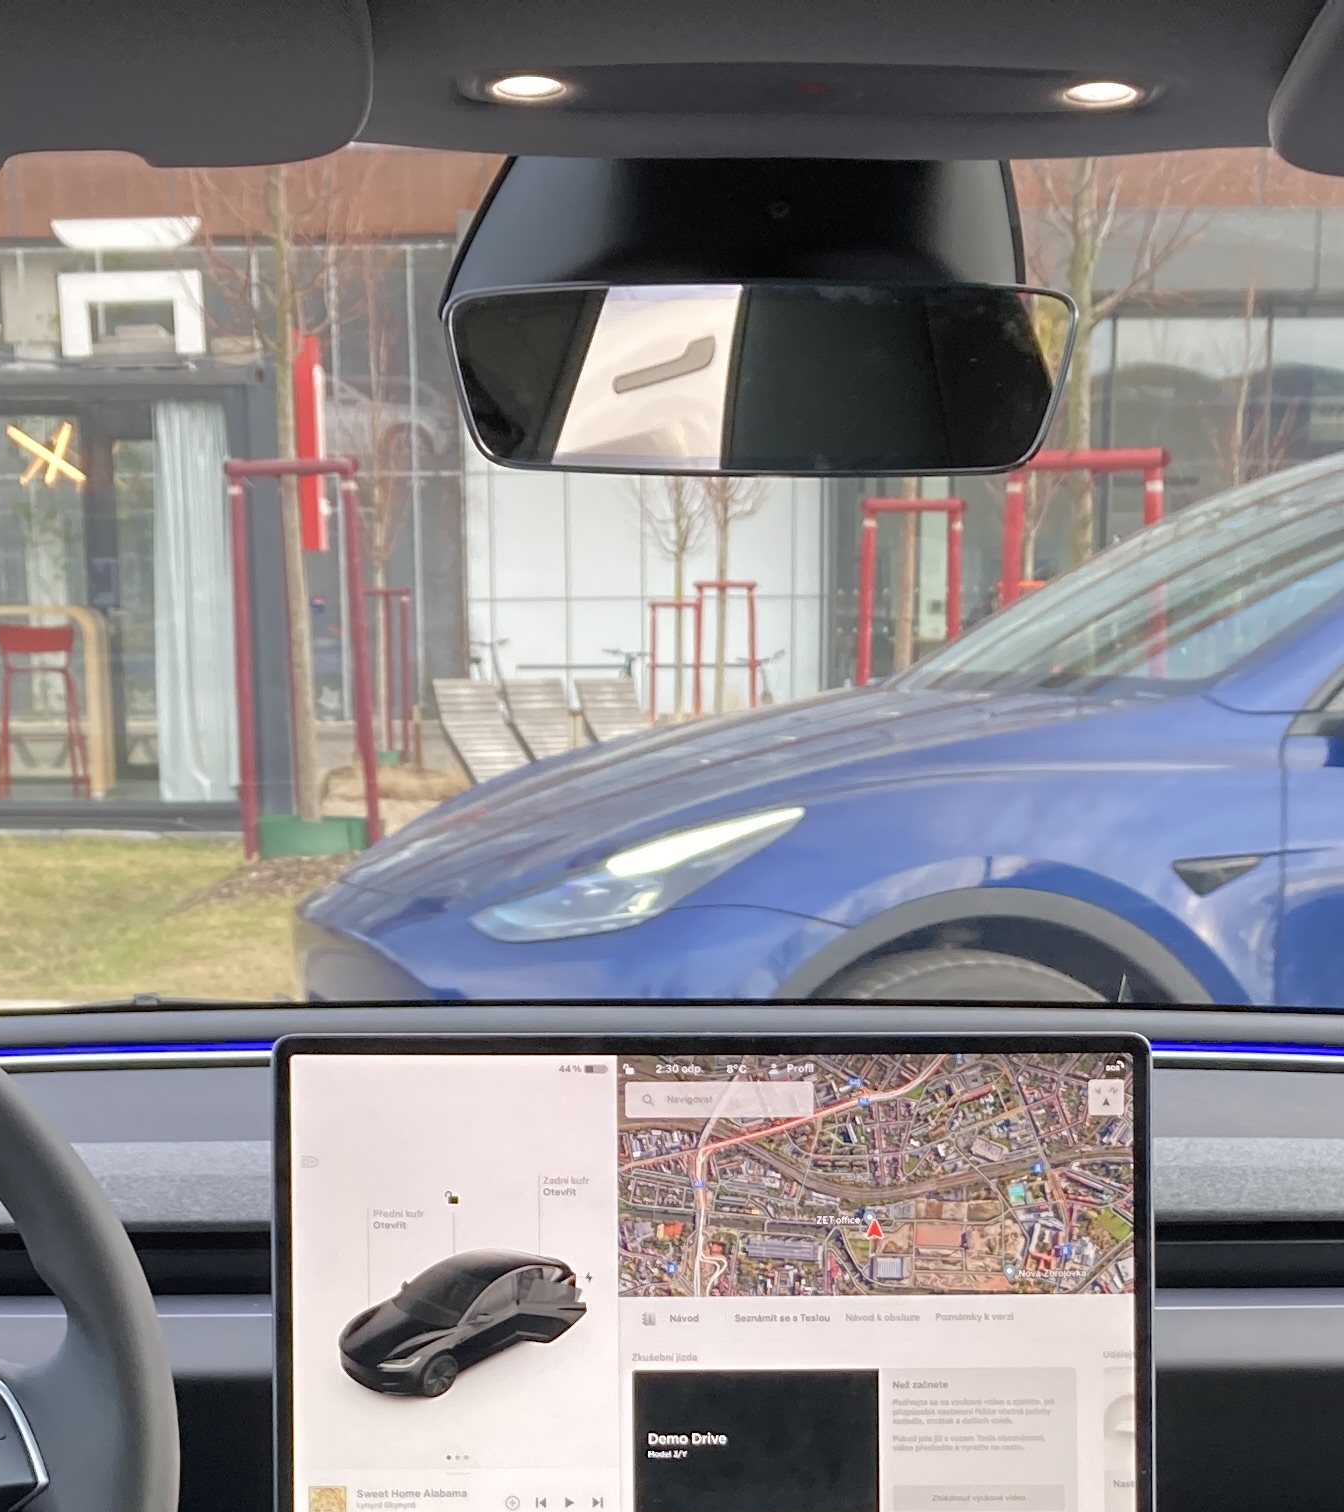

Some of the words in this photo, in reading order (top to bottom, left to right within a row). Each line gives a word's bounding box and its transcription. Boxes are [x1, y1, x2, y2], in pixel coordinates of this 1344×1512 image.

[655, 1064, 678, 1074] 2:30
[726, 1064, 747, 1074] 8°C
[786, 1064, 815, 1073] Profil
[666, 1094, 713, 1105] Navigovat
[816, 1215, 834, 1225] ZET
[836, 1215, 861, 1225] office
[669, 1313, 700, 1323] Návod
[734, 1313, 778, 1323] Seznámit
[779, 1315, 791, 1323] se
[647, 1432, 689, 1445] Demo
[691, 1431, 729, 1445] Drive
[356, 1489, 389, 1498] Sweet
[391, 1489, 421, 1498] Home
[423, 1488, 468, 1498] Alabama
